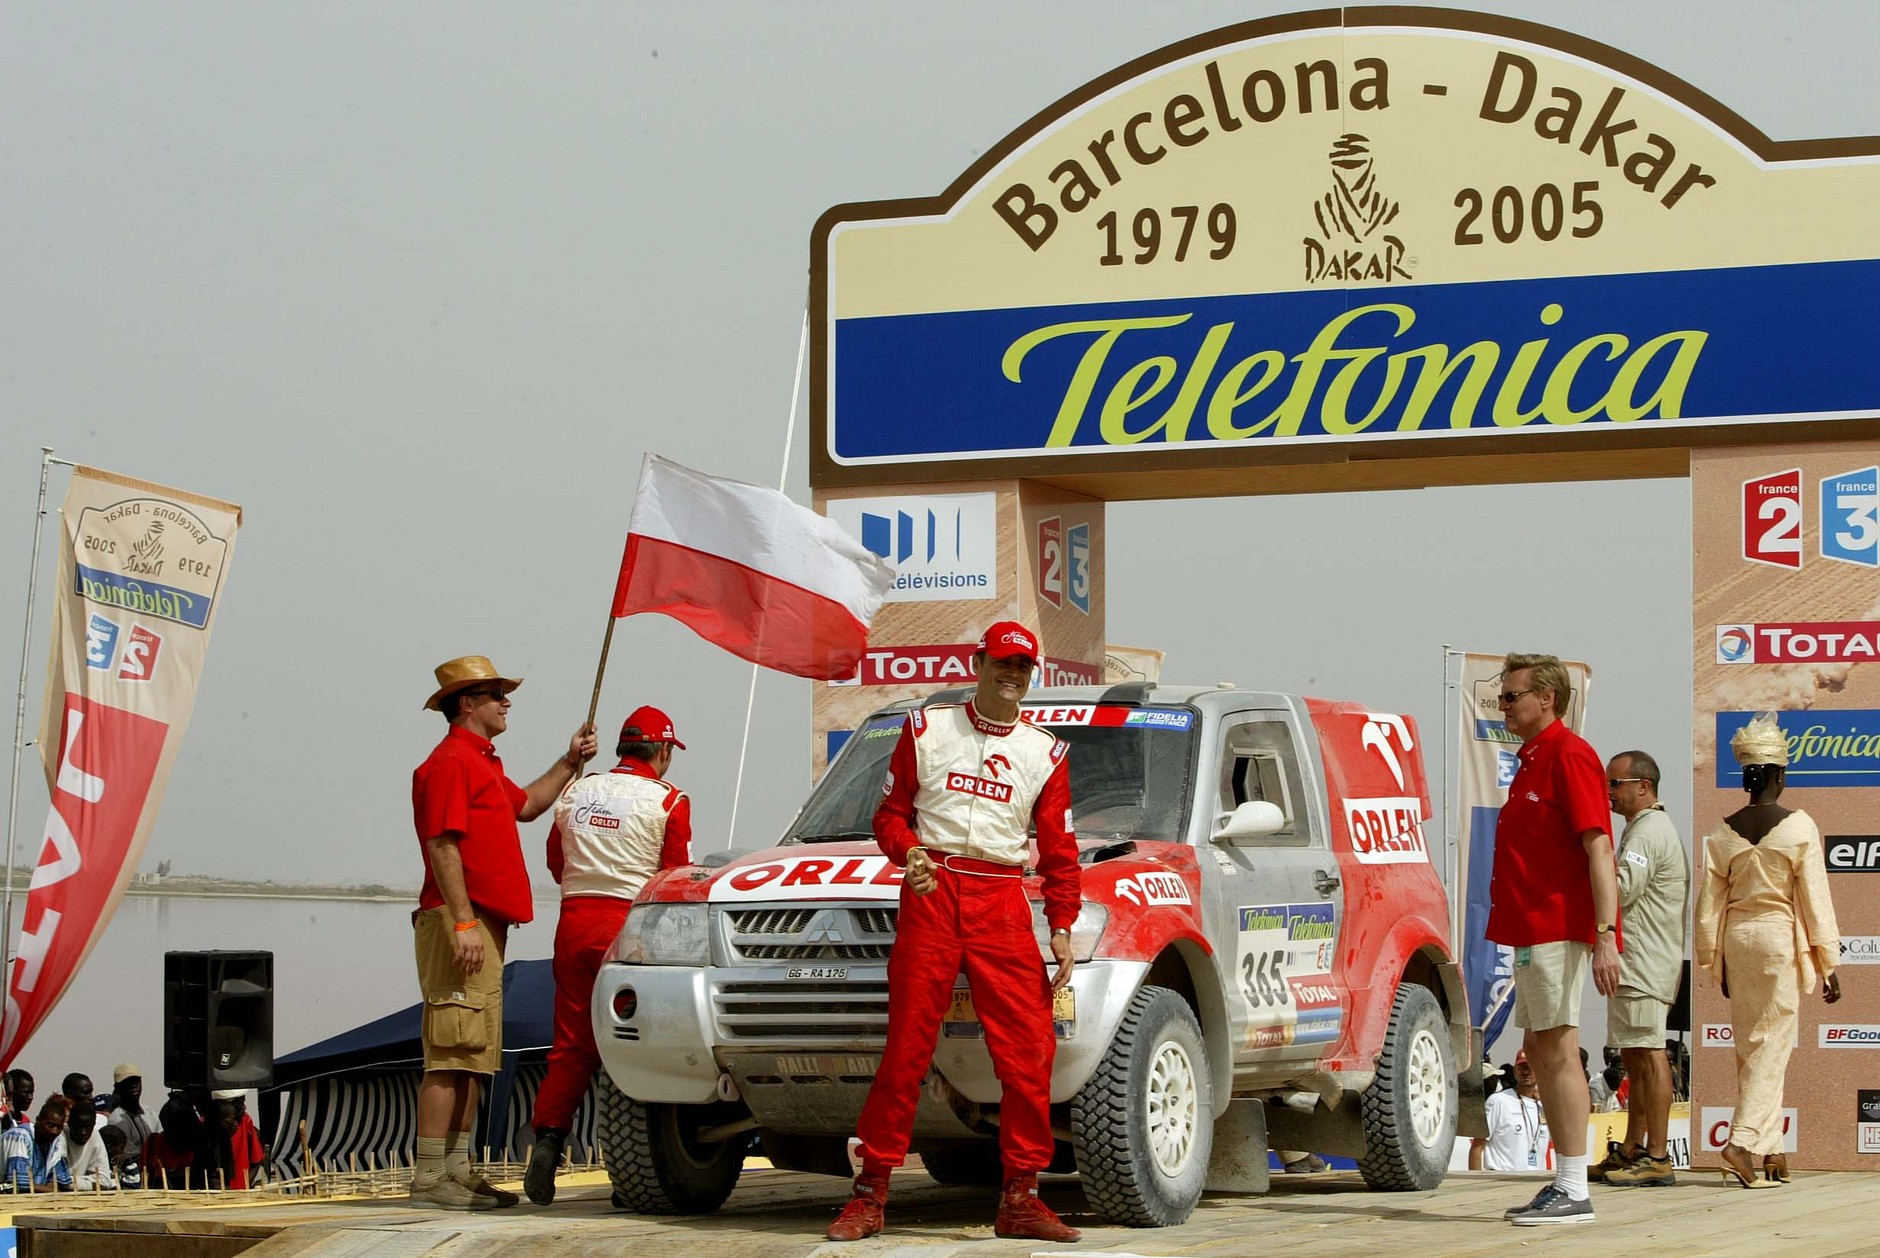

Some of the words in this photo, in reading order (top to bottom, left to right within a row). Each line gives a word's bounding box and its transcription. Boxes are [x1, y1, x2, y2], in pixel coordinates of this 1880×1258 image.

[992, 55, 1390, 252] Barcelona
[1479, 51, 1716, 210] Dakar
[1096, 202, 1237, 266] 1979
[1454, 181, 1604, 245] 2005
[1303, 235, 1413, 284] DAKAR
[1758, 484, 1798, 495] france
[1836, 481, 1876, 493] france
[1757, 496, 1800, 553] 2
[1835, 494, 1878, 551] 3
[892, 572, 987, 590] élévisions
[1044, 540, 1062, 593] 2
[1073, 546, 1089, 599] 3
[1760, 628, 1880, 658] TOTA
[1020, 708, 1088, 724] RLEN
[1147, 712, 1188, 722] FIDELIA
[950, 776, 1008, 800] ORLEN
[591, 817, 618, 829] ORLEN
[1351, 808, 1422, 855] ORLEN
[730, 859, 906, 892] ORLE
[1144, 877, 1188, 900] ORLEN
[1242, 950, 1288, 1008] 365
[1292, 982, 1337, 1004] TOTAL
[1256, 1030, 1283, 1046] TOTAL
